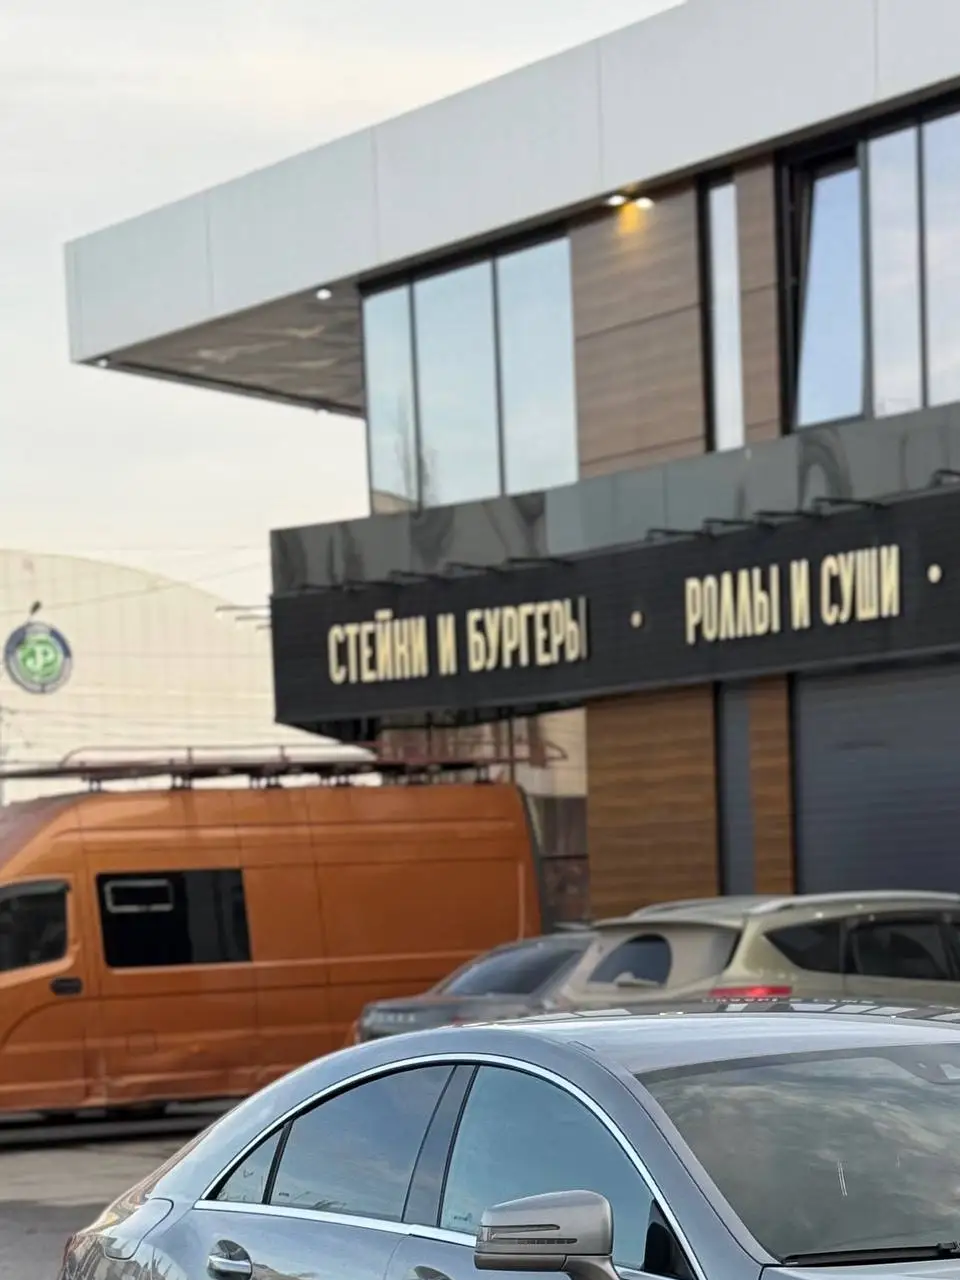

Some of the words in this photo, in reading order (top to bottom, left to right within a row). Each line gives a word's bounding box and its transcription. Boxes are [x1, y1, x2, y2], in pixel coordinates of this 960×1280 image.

[327, 609, 428, 684] СТЕЙКИ
[436, 613, 457, 675] И
[467, 597, 588, 672] БУРГЕРЫ
[684, 565, 781, 644] РОЛЛЫ
[790, 558, 811, 629] И
[820, 545, 900, 625] СУШИ
